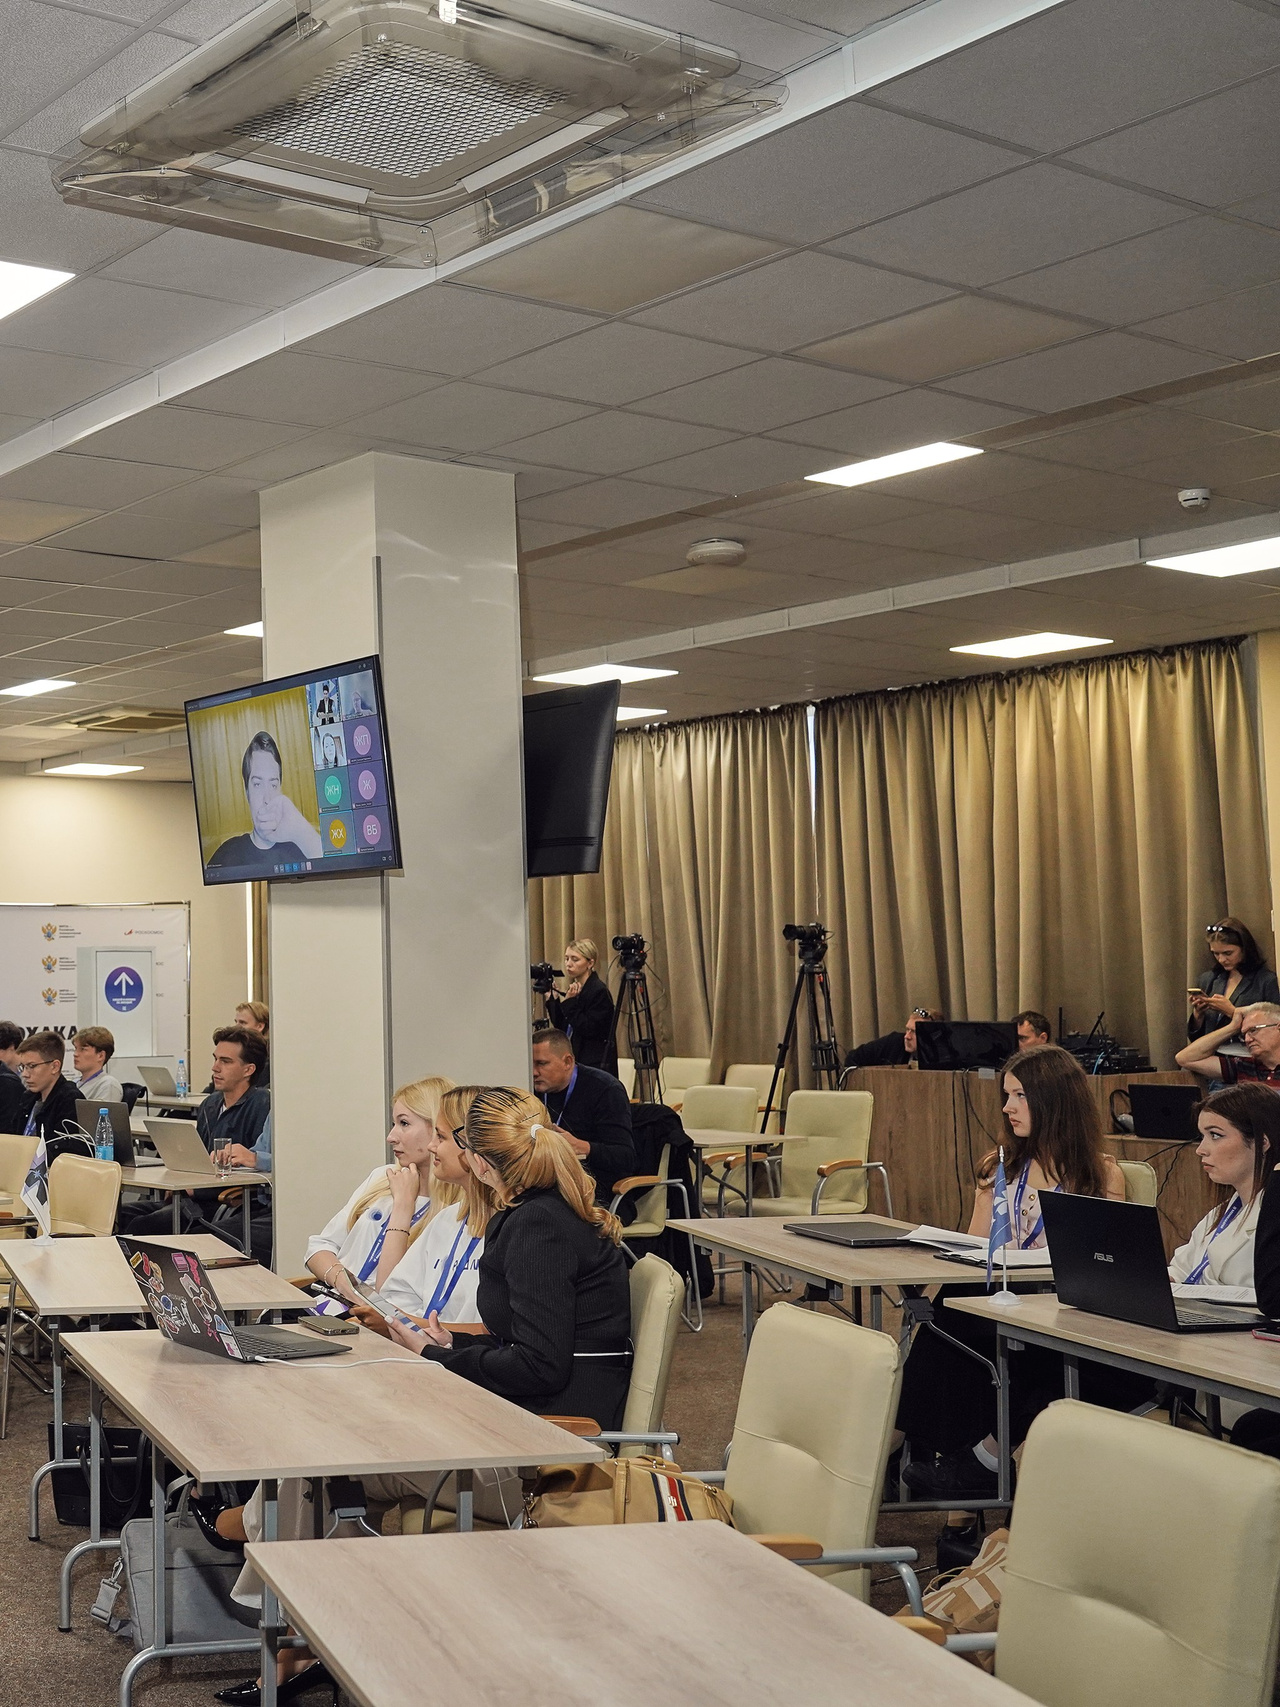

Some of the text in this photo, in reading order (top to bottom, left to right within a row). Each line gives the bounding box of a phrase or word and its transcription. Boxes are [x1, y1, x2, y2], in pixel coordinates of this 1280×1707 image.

[326, 784, 340, 796] ЖН
[363, 779, 372, 791] Ж
[331, 828, 345, 840] ЖХ
[366, 824, 378, 836] ВБ
[1094, 1252, 1114, 1263] ASUS
